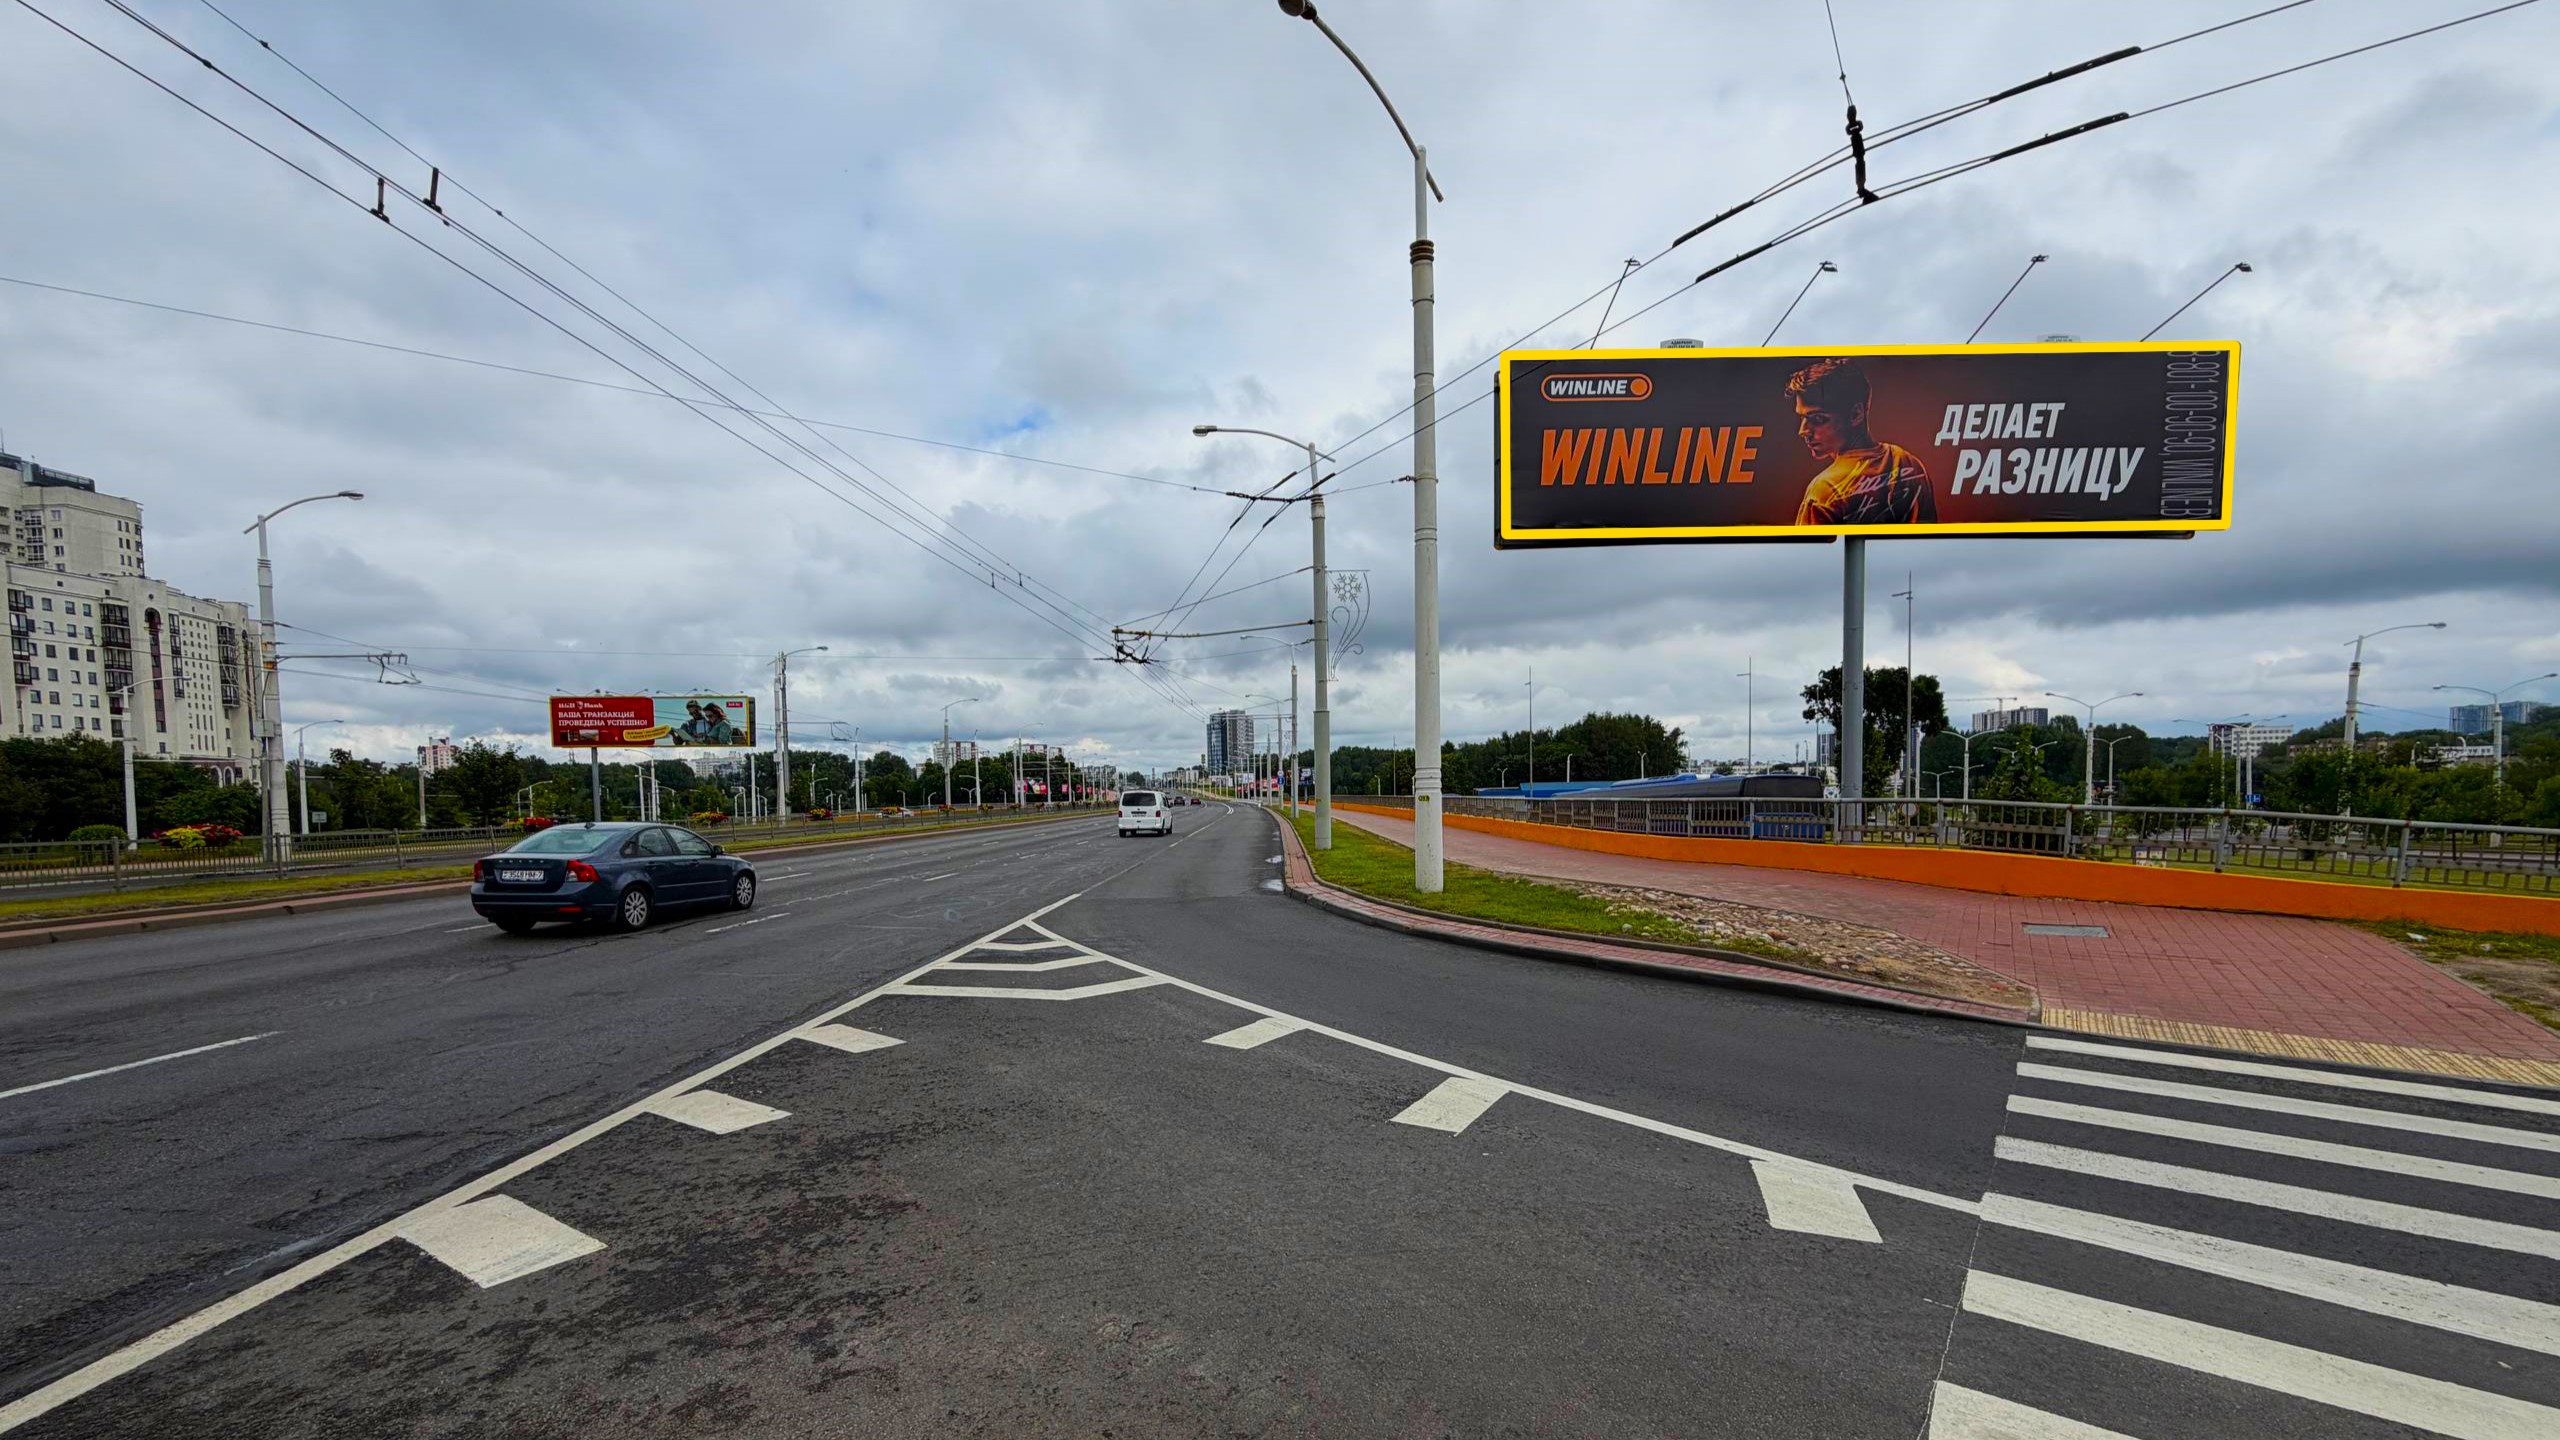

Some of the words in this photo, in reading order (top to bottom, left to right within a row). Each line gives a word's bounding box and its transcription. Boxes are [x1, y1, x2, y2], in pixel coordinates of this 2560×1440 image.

[1550, 379, 1628, 396] WINLINE
[1934, 402, 2066, 447] ДЕЛАЕТ
[1540, 426, 1764, 486] WINLINE
[1950, 447, 2146, 501] РАЗНИЦУ
[558, 711, 581, 719] ВАША
[583, 711, 635, 719] ТРАНЗАКЦИЯ
[558, 719, 605, 727] ПРОВЕДЕНА
[607, 719, 648, 727] УСПЕШНО!
